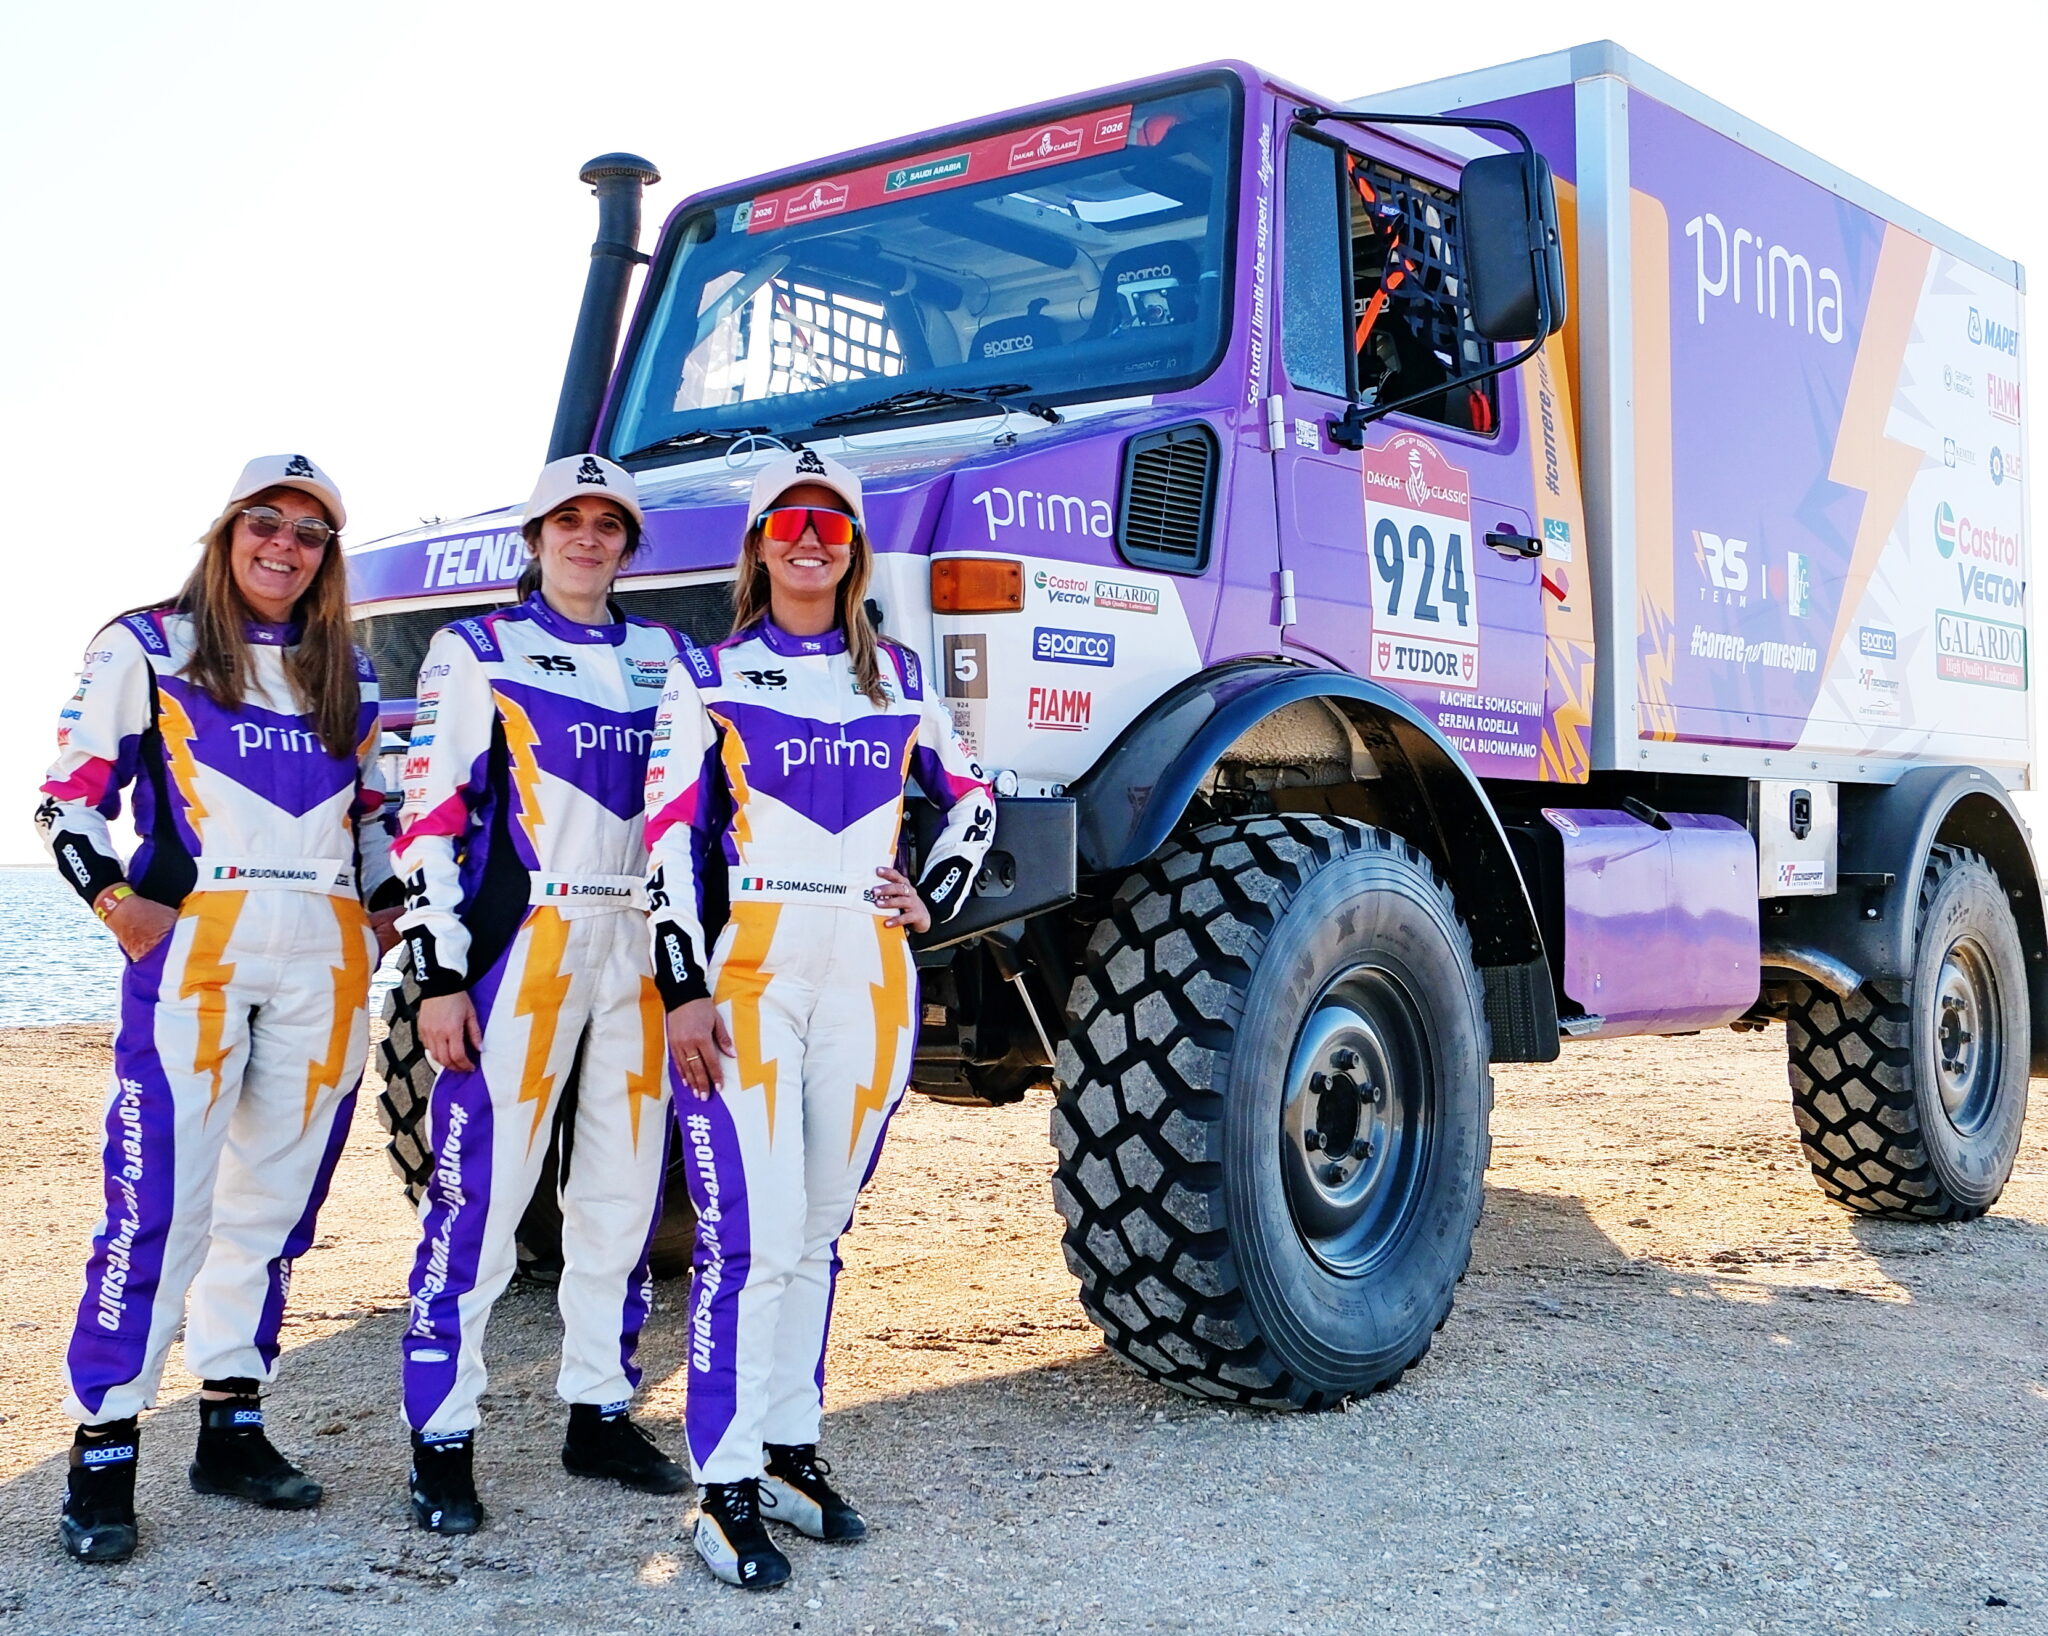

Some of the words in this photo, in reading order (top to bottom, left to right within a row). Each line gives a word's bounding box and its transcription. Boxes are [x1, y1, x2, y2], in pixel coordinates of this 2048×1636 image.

[1101, 121, 1123, 136] 2026
[1013, 151, 1034, 161] DAKAR
[1053, 140, 1078, 152] CLASSIC
[910, 168, 932, 181] SAUDI
[933, 162, 961, 176] ARABIA
[754, 207, 773, 218] 2026
[1253, 252, 1266, 284] che
[1685, 212, 1843, 344] prima
[1251, 284, 1264, 329] limiti
[983, 335, 1033, 358] sparco
[1249, 338, 1262, 378] tutti
[1988, 373, 2021, 417] FIAMM
[1367, 470, 1401, 490] DAKAR
[1431, 486, 1467, 505] CLASSIC
[972, 487, 1113, 541] prima
[1958, 517, 2019, 568] Castrol
[1373, 518, 1469, 627] 924
[1700, 531, 1749, 592] RS
[1048, 590, 1090, 605] VECTON
[1049, 576, 1088, 591] Castrol
[1096, 584, 1157, 604] GALARDO
[1700, 588, 1746, 608] TEAM
[1958, 561, 2026, 609] VECTON
[460, 619, 494, 653] sparco
[1038, 632, 1109, 659] sparco
[1861, 632, 1894, 651] sparco
[1938, 616, 2022, 664] GALARDO
[528, 654, 577, 672] RS
[953, 648, 979, 681] 5
[1395, 646, 1458, 676] TUDOR
[1945, 658, 1963, 676] High
[1963, 661, 1984, 681] Quality
[1984, 664, 2017, 684] Lubricants
[740, 668, 788, 686] RS
[1028, 687, 1092, 724] FIAMM
[1439, 690, 1484, 710] RACHELE
[1485, 697, 1542, 717] SOMASCHINI
[230, 721, 327, 758] prim
[1438, 712, 1475, 731] SERENA
[1477, 717, 1519, 736] RODELLA
[566, 721, 654, 759] prim
[1446, 735, 1476, 752] ONICA
[1478, 739, 1537, 758] BUONAMANO
[404, 756, 431, 775] AMM
[774, 736, 891, 776] prima
[962, 804, 992, 842] RS
[62, 843, 90, 888] sparco
[237, 868, 318, 881] M.BUONAMANO
[571, 885, 632, 897] S.RODELLA
[646, 865, 671, 912] RS
[766, 879, 847, 895] R.SOMASCHINI
[929, 866, 961, 903] sparco
[411, 937, 430, 982] sparc
[664, 933, 688, 983] sparco
[234, 1410, 265, 1424] spar
[83, 1445, 134, 1462] sparco
